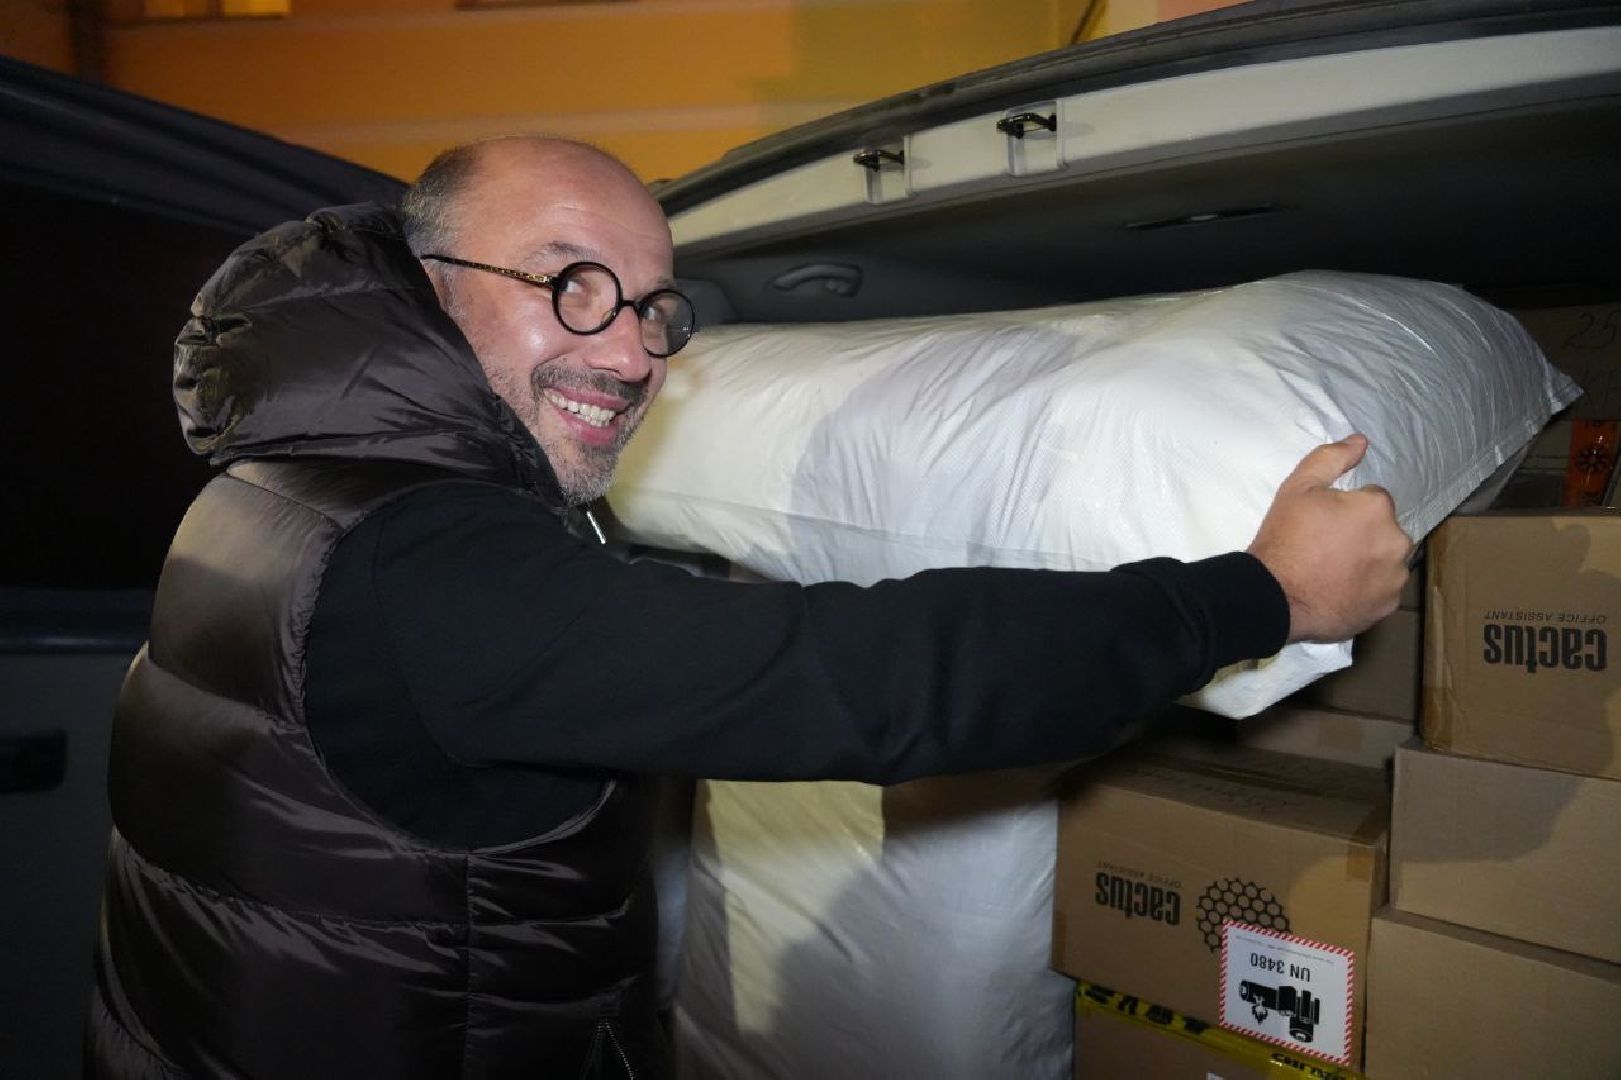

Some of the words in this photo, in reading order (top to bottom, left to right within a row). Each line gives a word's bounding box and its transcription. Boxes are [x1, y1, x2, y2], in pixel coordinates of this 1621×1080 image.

[1484, 610, 1553, 622] ASSISTANT
[1557, 613, 1606, 624] OFFICE
[1483, 624, 1607, 673] cactus
[1095, 872, 1181, 926] cactus
[1250, 953, 1285, 974] 3480
[1289, 963, 1311, 983] UN
